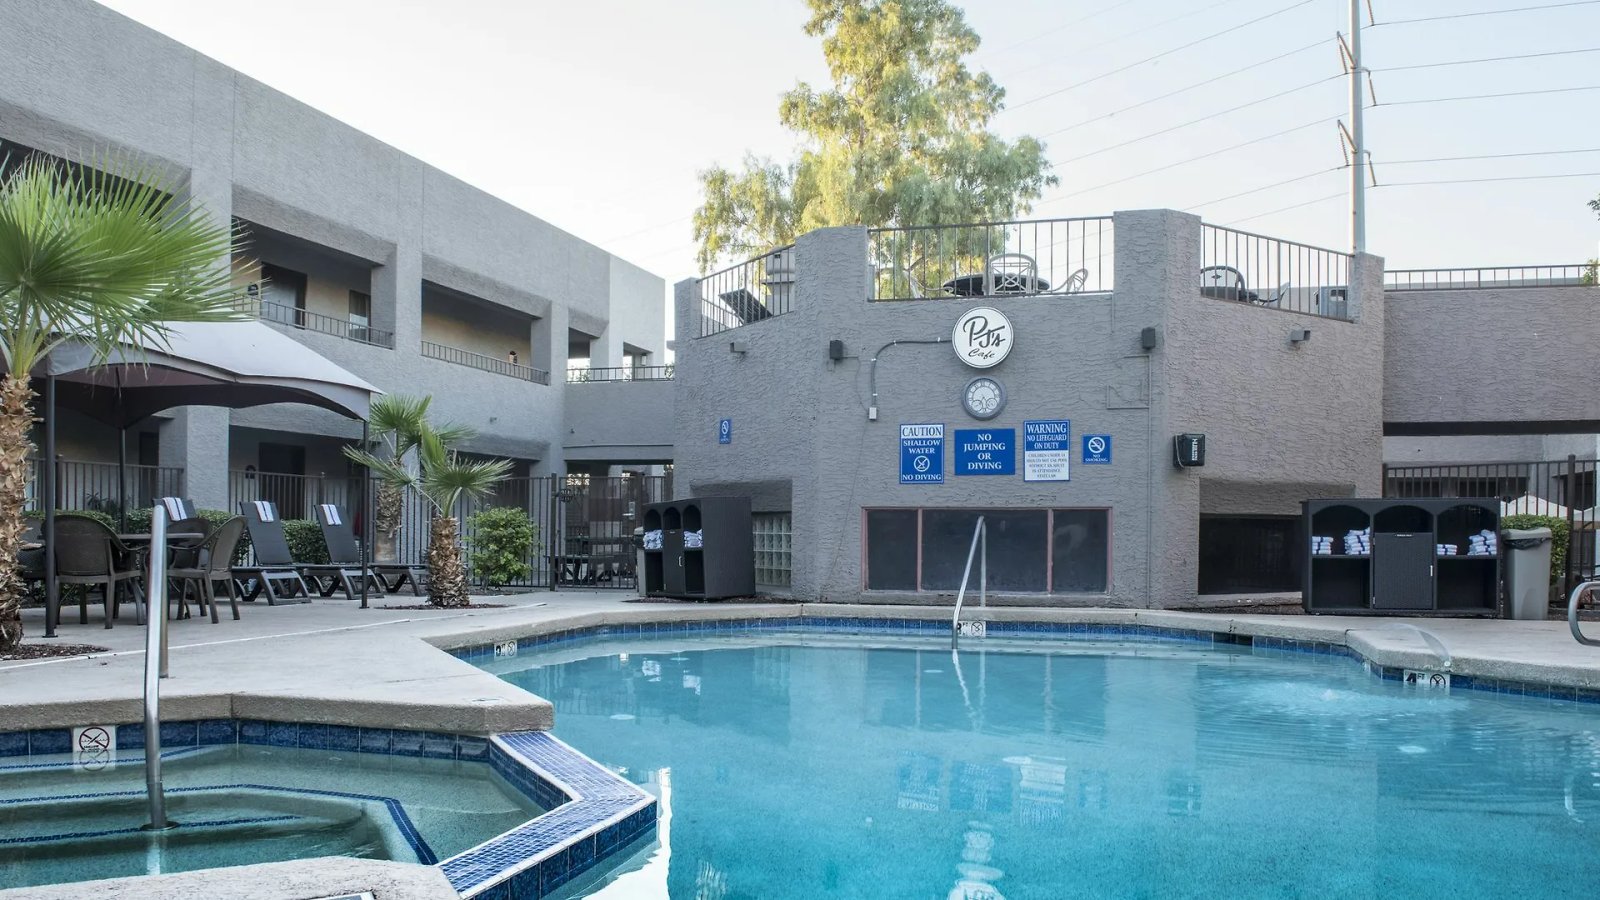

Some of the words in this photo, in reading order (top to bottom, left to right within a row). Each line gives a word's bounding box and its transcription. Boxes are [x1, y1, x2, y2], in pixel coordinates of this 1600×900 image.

[963, 316, 1006, 348] PJ's
[968, 348, 996, 359] Cafe
[902, 426, 942, 437] CAUTION
[1027, 423, 1067, 434] WARNING
[977, 433, 992, 442] NO
[1037, 433, 1067, 442] LIFEGUARD
[963, 442, 1006, 453] JUMPING
[1034, 442, 1043, 450] ON
[1044, 441, 1059, 450] DUTY
[977, 452, 992, 461] OR
[967, 461, 1002, 470] DIVING
[915, 473, 942, 481] DIVING
